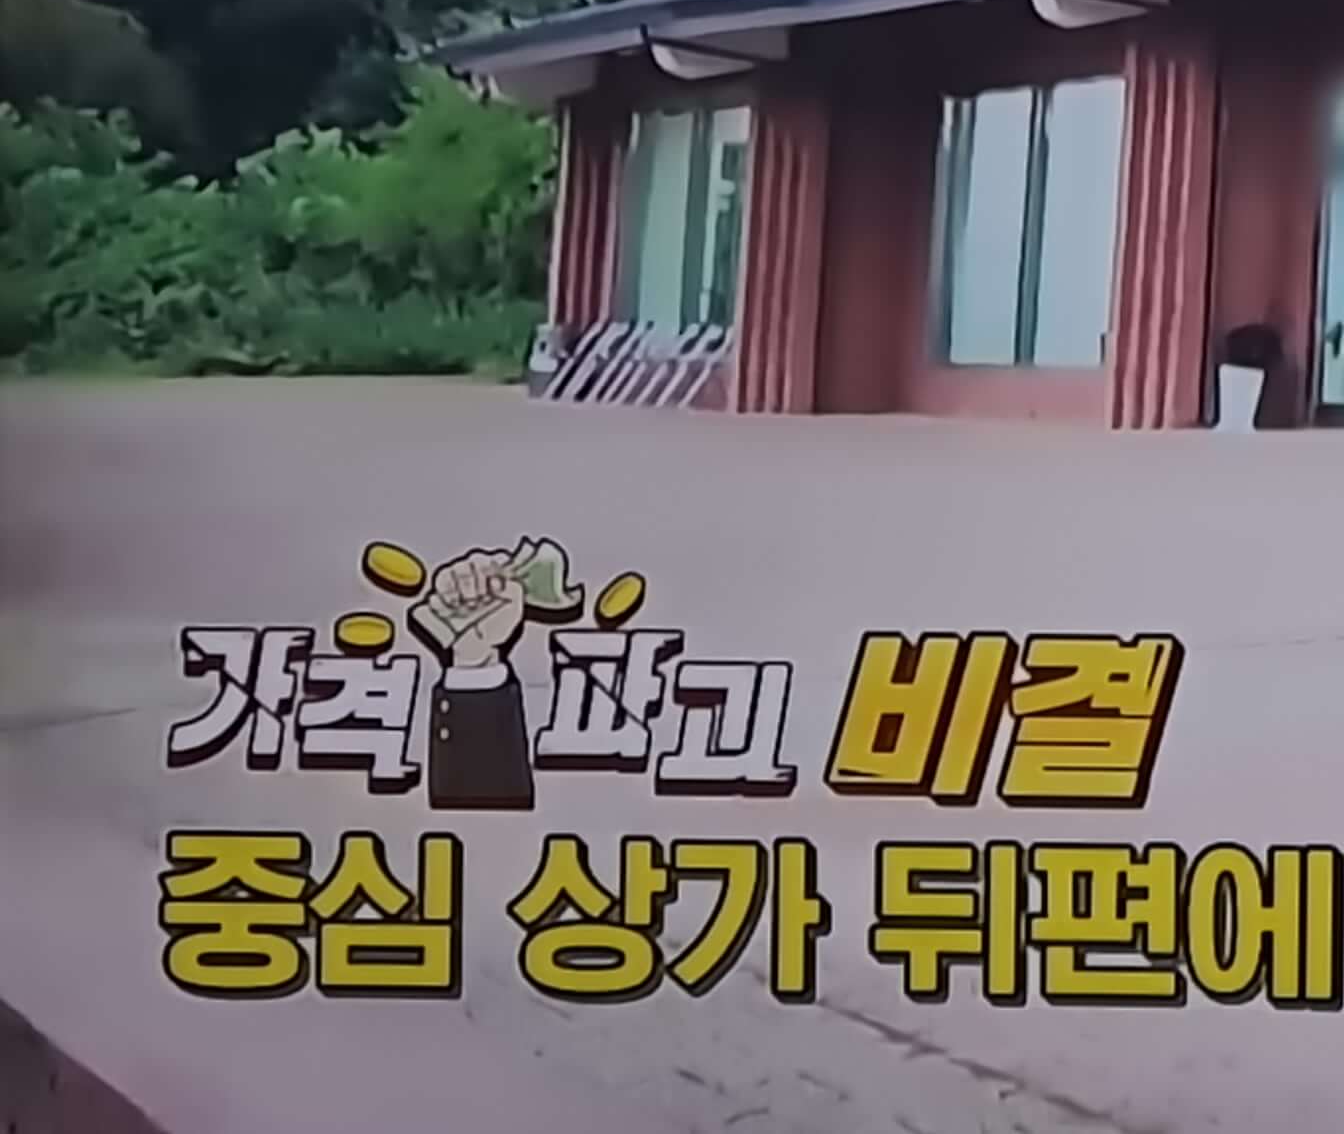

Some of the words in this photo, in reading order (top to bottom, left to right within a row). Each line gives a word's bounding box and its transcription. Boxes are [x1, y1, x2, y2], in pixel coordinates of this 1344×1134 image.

[822, 631, 1184, 804] 비결
[160, 831, 463, 998] 중심
[506, 836, 830, 1002] 상가
[868, 840, 1344, 1008] 뒤편에
